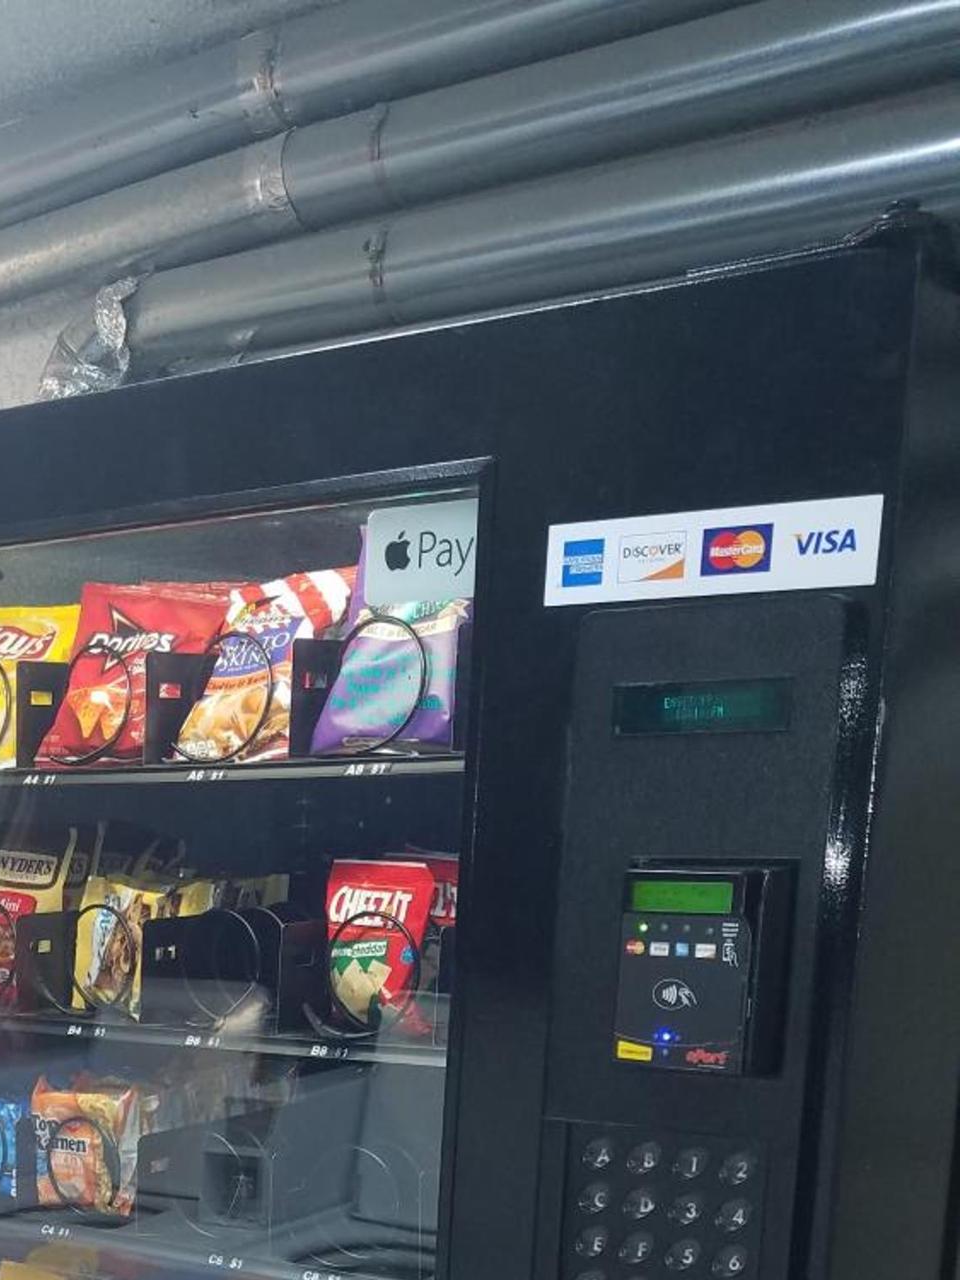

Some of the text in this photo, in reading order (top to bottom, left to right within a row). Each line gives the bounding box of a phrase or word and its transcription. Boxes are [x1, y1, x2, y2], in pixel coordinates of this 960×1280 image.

[419, 530, 474, 576] Pay
[623, 541, 682, 559] DISCOVER
[796, 528, 858, 556] VISA
[736, 1161, 747, 1178] 2
[594, 1192, 745, 1224] C D 3 4
[593, 1236, 740, 1271] E F 5 6
